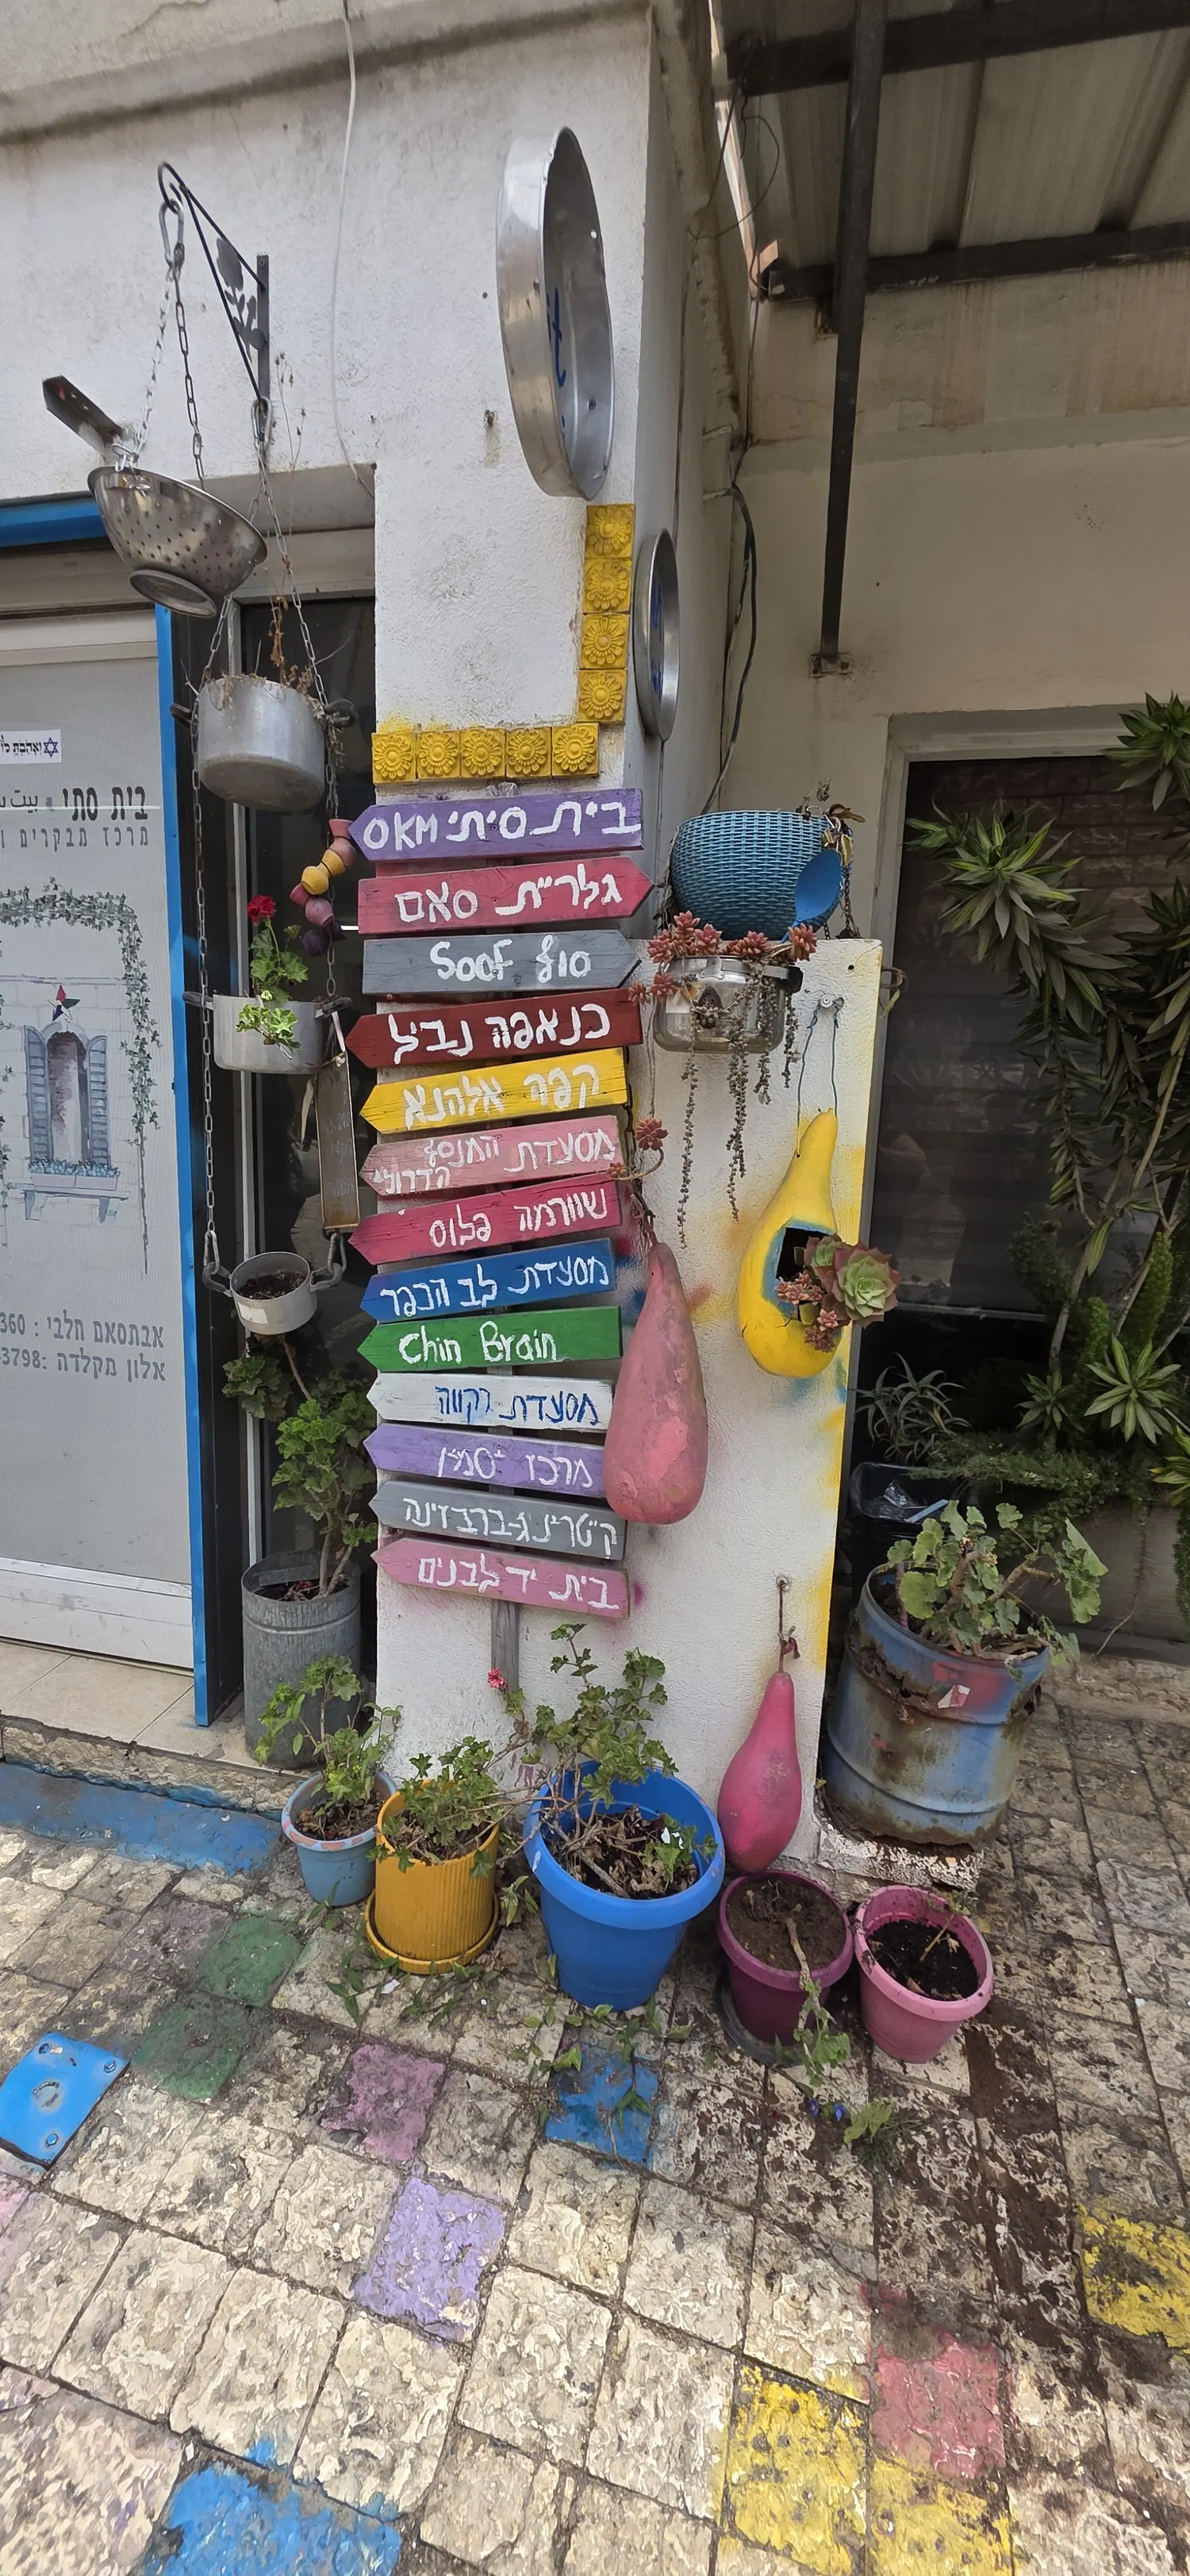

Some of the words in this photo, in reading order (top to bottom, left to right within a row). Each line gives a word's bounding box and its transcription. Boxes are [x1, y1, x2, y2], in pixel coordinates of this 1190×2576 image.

[10, 789, 38, 814] بيت
[63, 787, 98, 821] סתי
[111, 786, 148, 820] בית
[530, 800, 642, 837] בית
[20, 827, 87, 852] מבקרים
[103, 827, 148, 847] מרכז
[363, 812, 438, 851] OKM
[446, 806, 527, 842] סיתי
[394, 881, 478, 923] סאם
[536, 935, 591, 983] סוף
[388, 1013, 474, 1065] נביל
[485, 1004, 611, 1050] כנאפה
[404, 1074, 505, 1131] אלהנא
[524, 1064, 599, 1109] קפה
[503, 1129, 616, 1173] מסעדת
[428, 1204, 492, 1247] פלוס
[514, 1188, 608, 1232] שוורמה
[458, 1263, 498, 1308] לב
[508, 1256, 610, 1295] מסעדת
[380, 1278, 450, 1317] הכפר
[47, 1309, 85, 1342] חלבי
[93, 1320, 164, 1349] אבתסאם
[398, 1326, 462, 1364] Chin
[479, 1321, 556, 1362] Brain
[57, 1347, 117, 1380] מקלדה
[127, 1353, 166, 1382] אלון
[498, 1391, 600, 1426] מסעדת
[437, 1446, 506, 1479] יסמין
[525, 1455, 593, 1488] מרכז
[418, 1553, 501, 1594] לבנים
[505, 1566, 537, 1593] יד
[548, 1574, 620, 1609] בית
